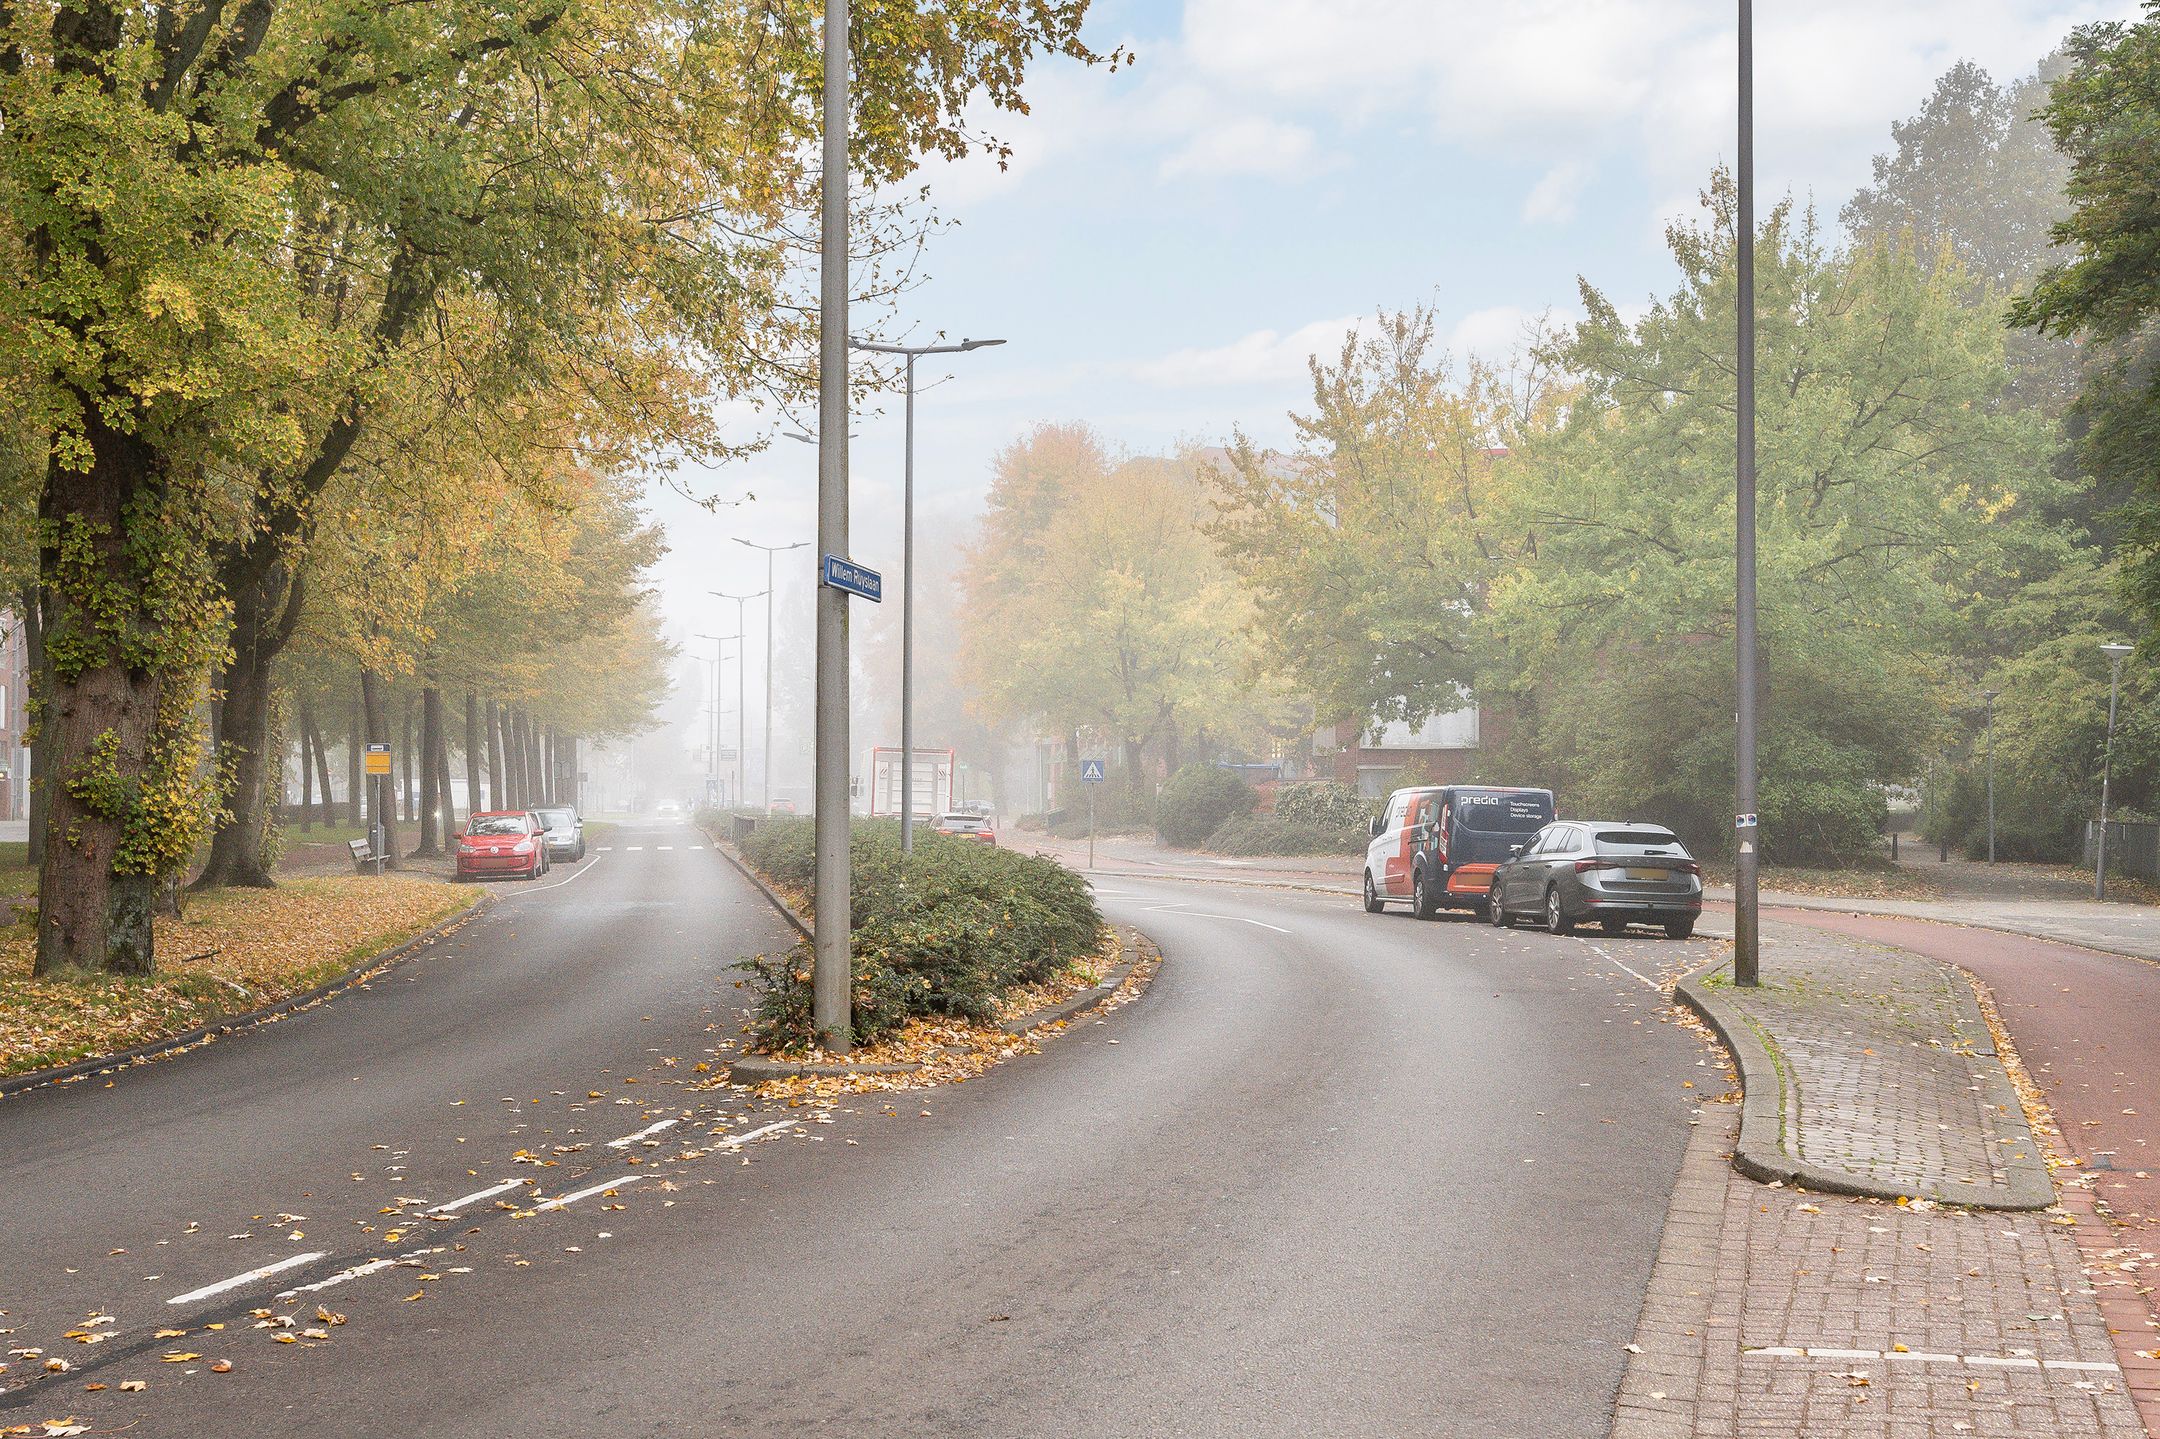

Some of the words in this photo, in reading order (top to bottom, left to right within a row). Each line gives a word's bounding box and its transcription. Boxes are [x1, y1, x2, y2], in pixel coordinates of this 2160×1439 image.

[831, 562, 853, 583] Willem
[853, 569, 880, 592] Ruyslaan
[1460, 796, 1499, 806] predia
